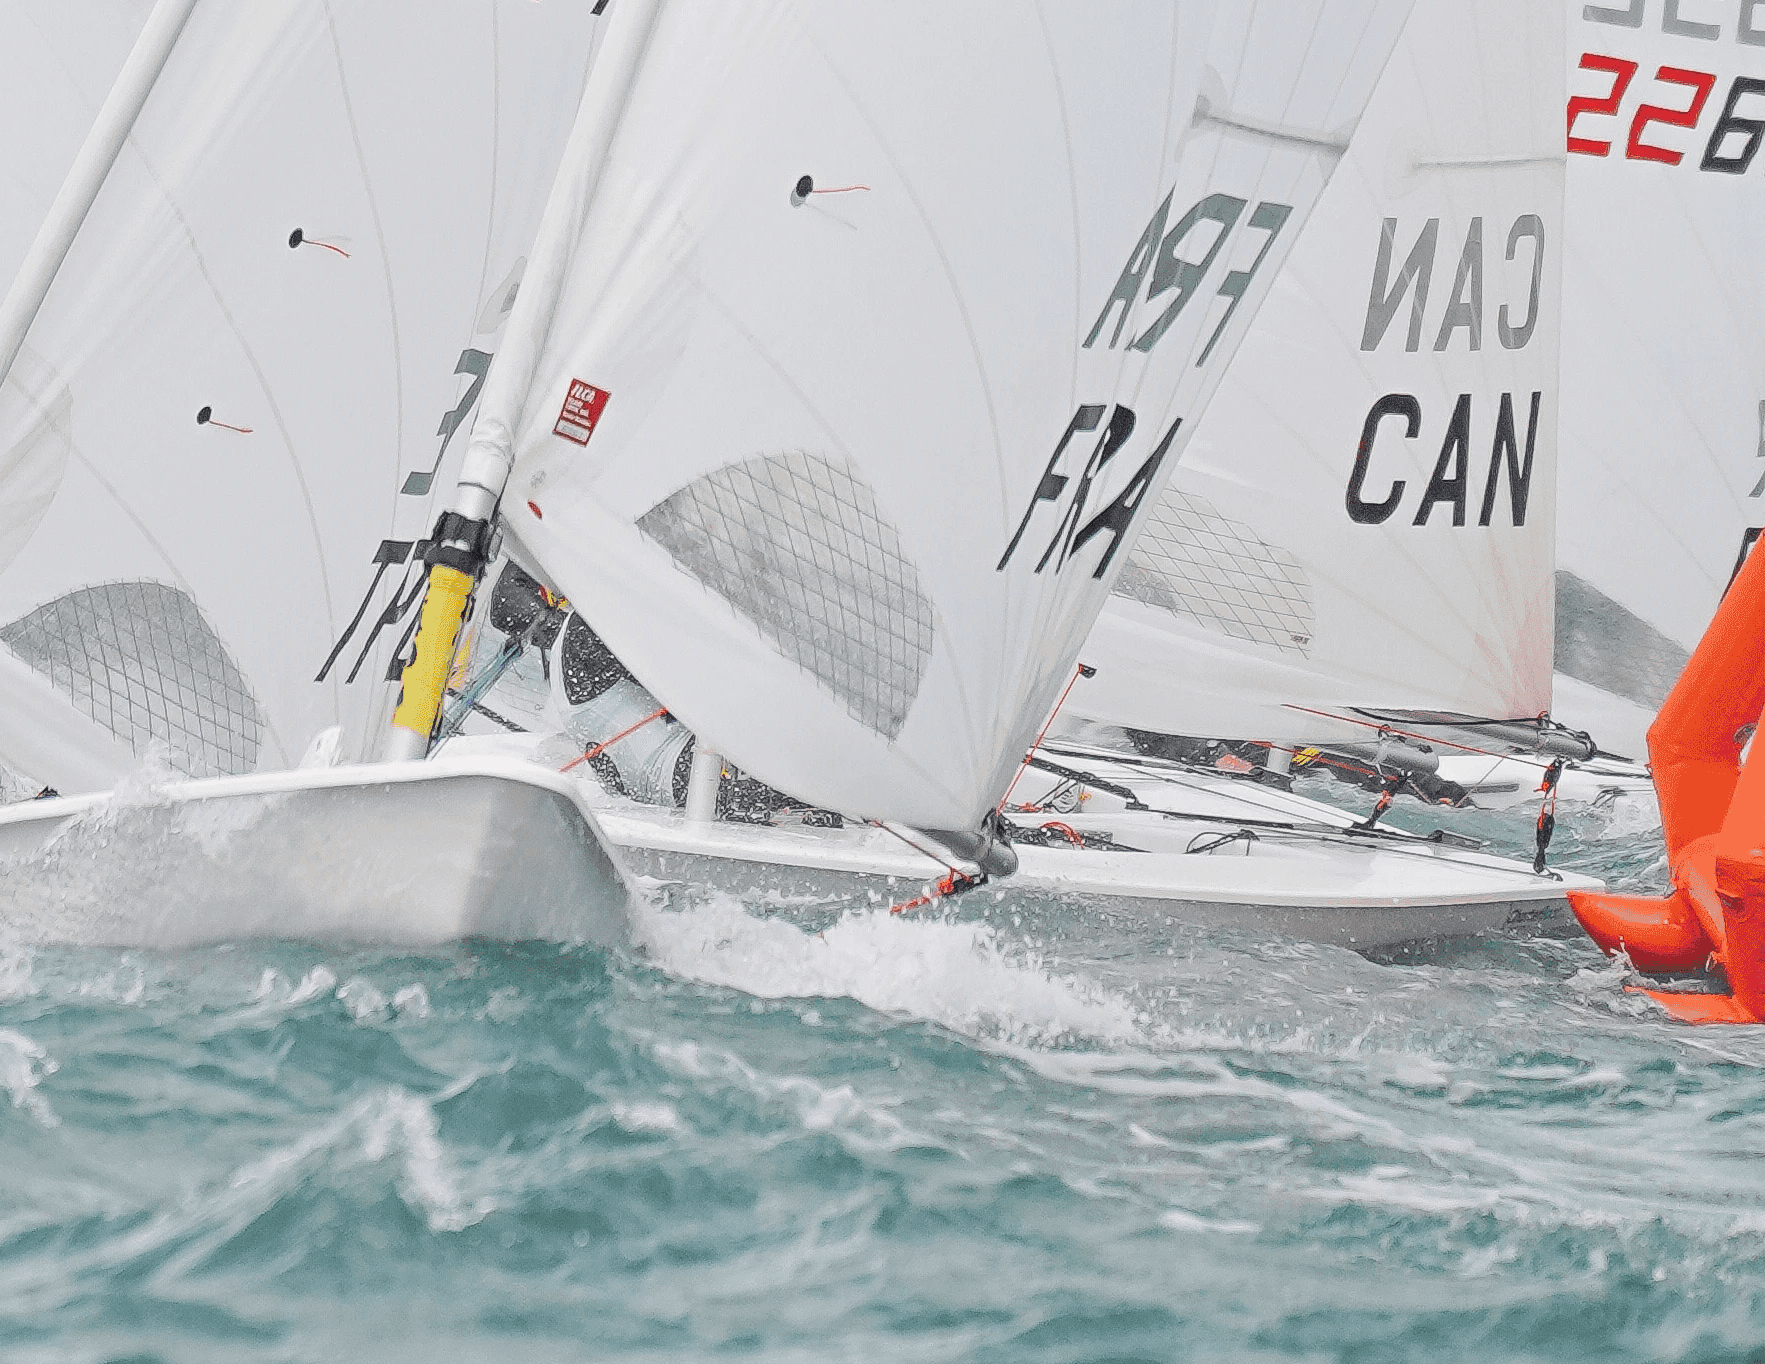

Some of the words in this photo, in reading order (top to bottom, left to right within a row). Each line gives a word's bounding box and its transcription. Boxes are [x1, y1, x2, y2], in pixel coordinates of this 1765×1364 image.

[1566, 52, 1765, 175] 226
[996, 403, 1184, 579] FRA
[1346, 391, 1542, 527] CAN
